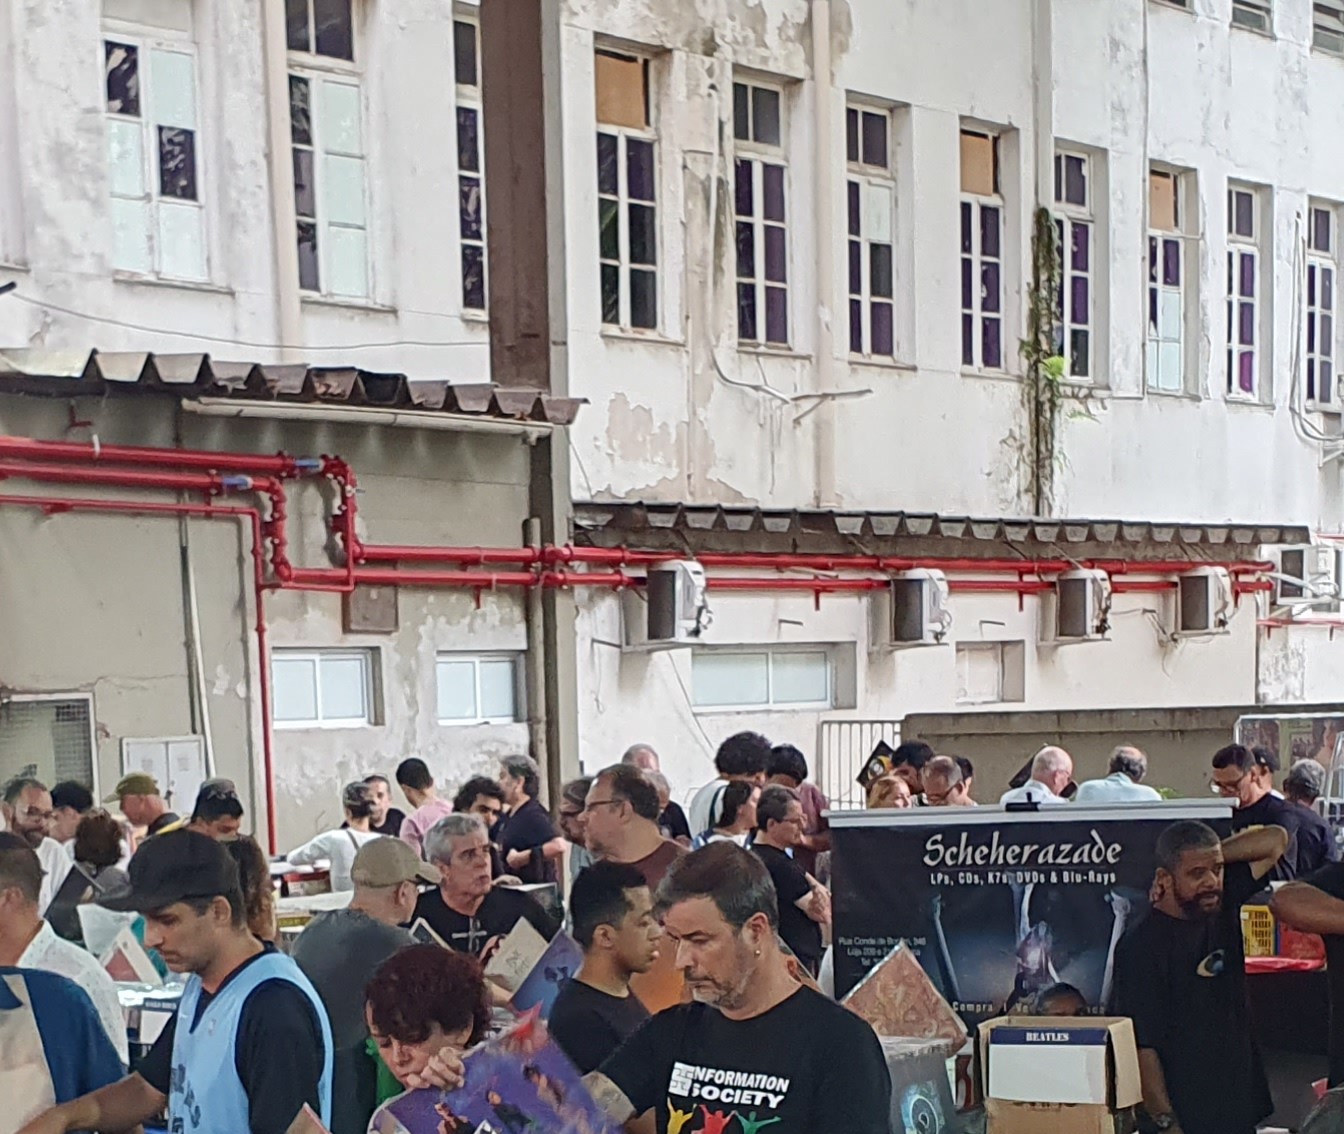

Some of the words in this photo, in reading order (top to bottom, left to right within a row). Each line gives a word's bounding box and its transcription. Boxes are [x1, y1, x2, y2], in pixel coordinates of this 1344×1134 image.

[923, 829, 1122, 867] Scheherazade
[1026, 1032, 1070, 1042] BEATLES
[691, 1082, 785, 1108] SOCIETY
